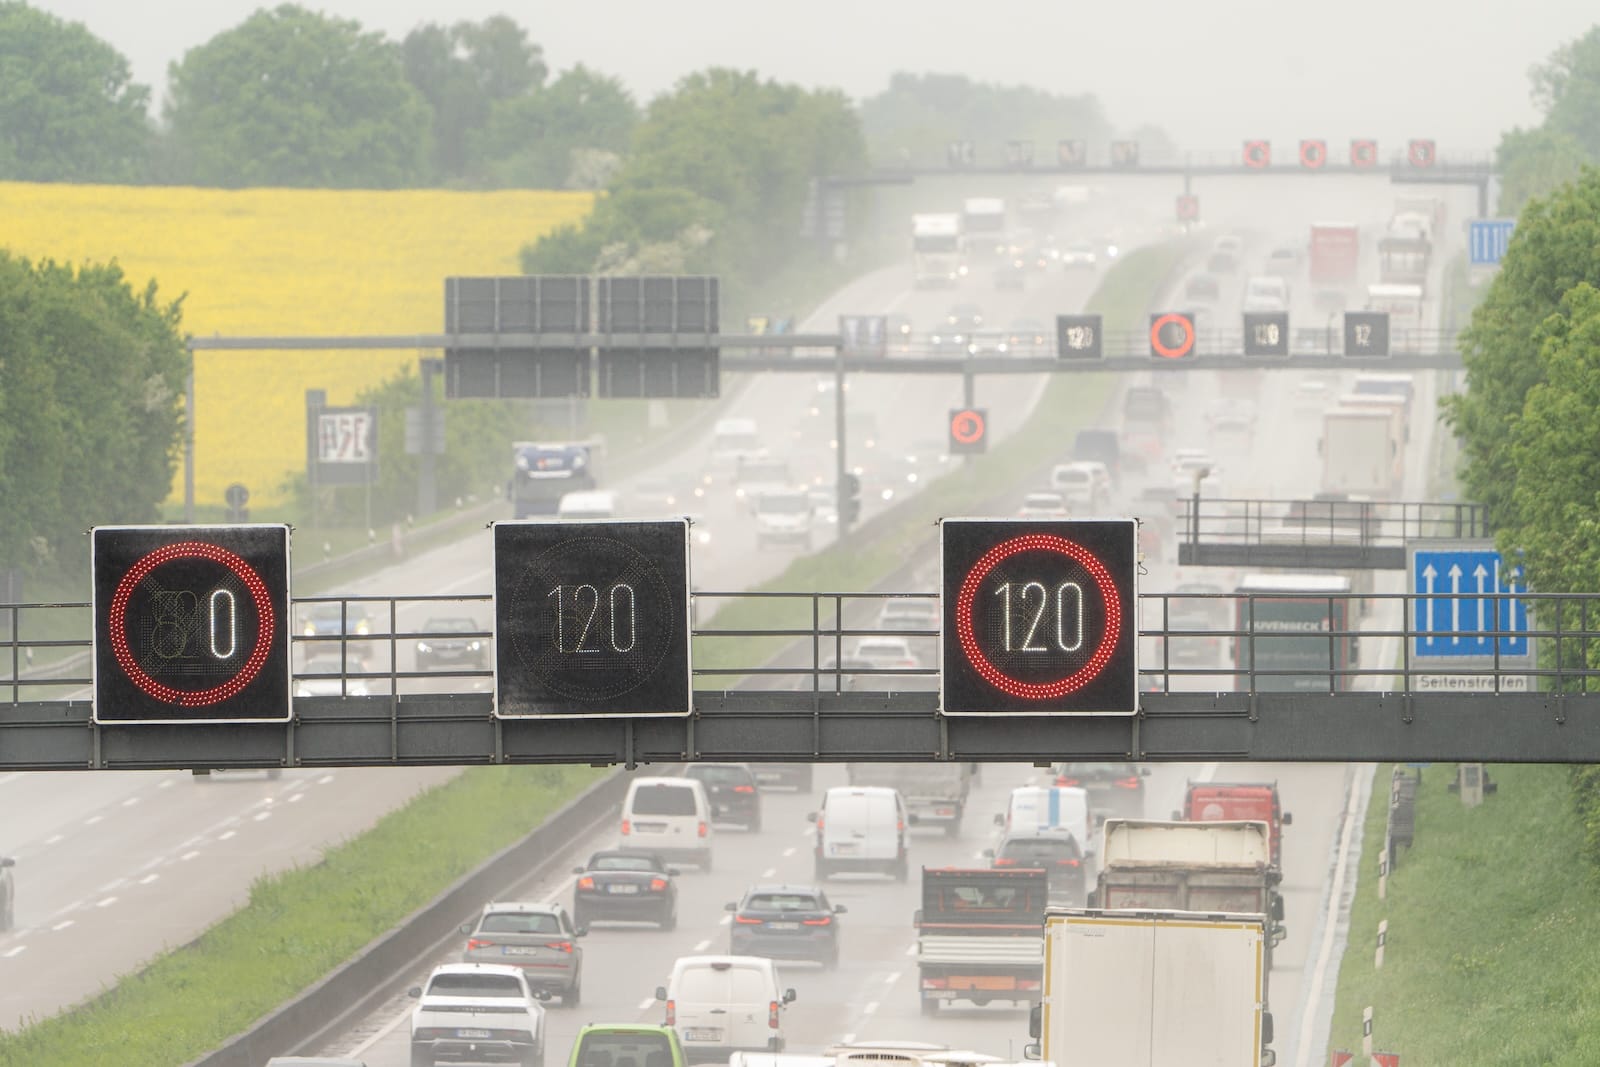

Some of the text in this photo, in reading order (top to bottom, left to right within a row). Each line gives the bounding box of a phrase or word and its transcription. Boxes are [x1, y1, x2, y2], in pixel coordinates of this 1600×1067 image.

[547, 584, 635, 653] 120
[994, 582, 1082, 652] 120
[1420, 675, 1524, 689] Seitenstrefen
